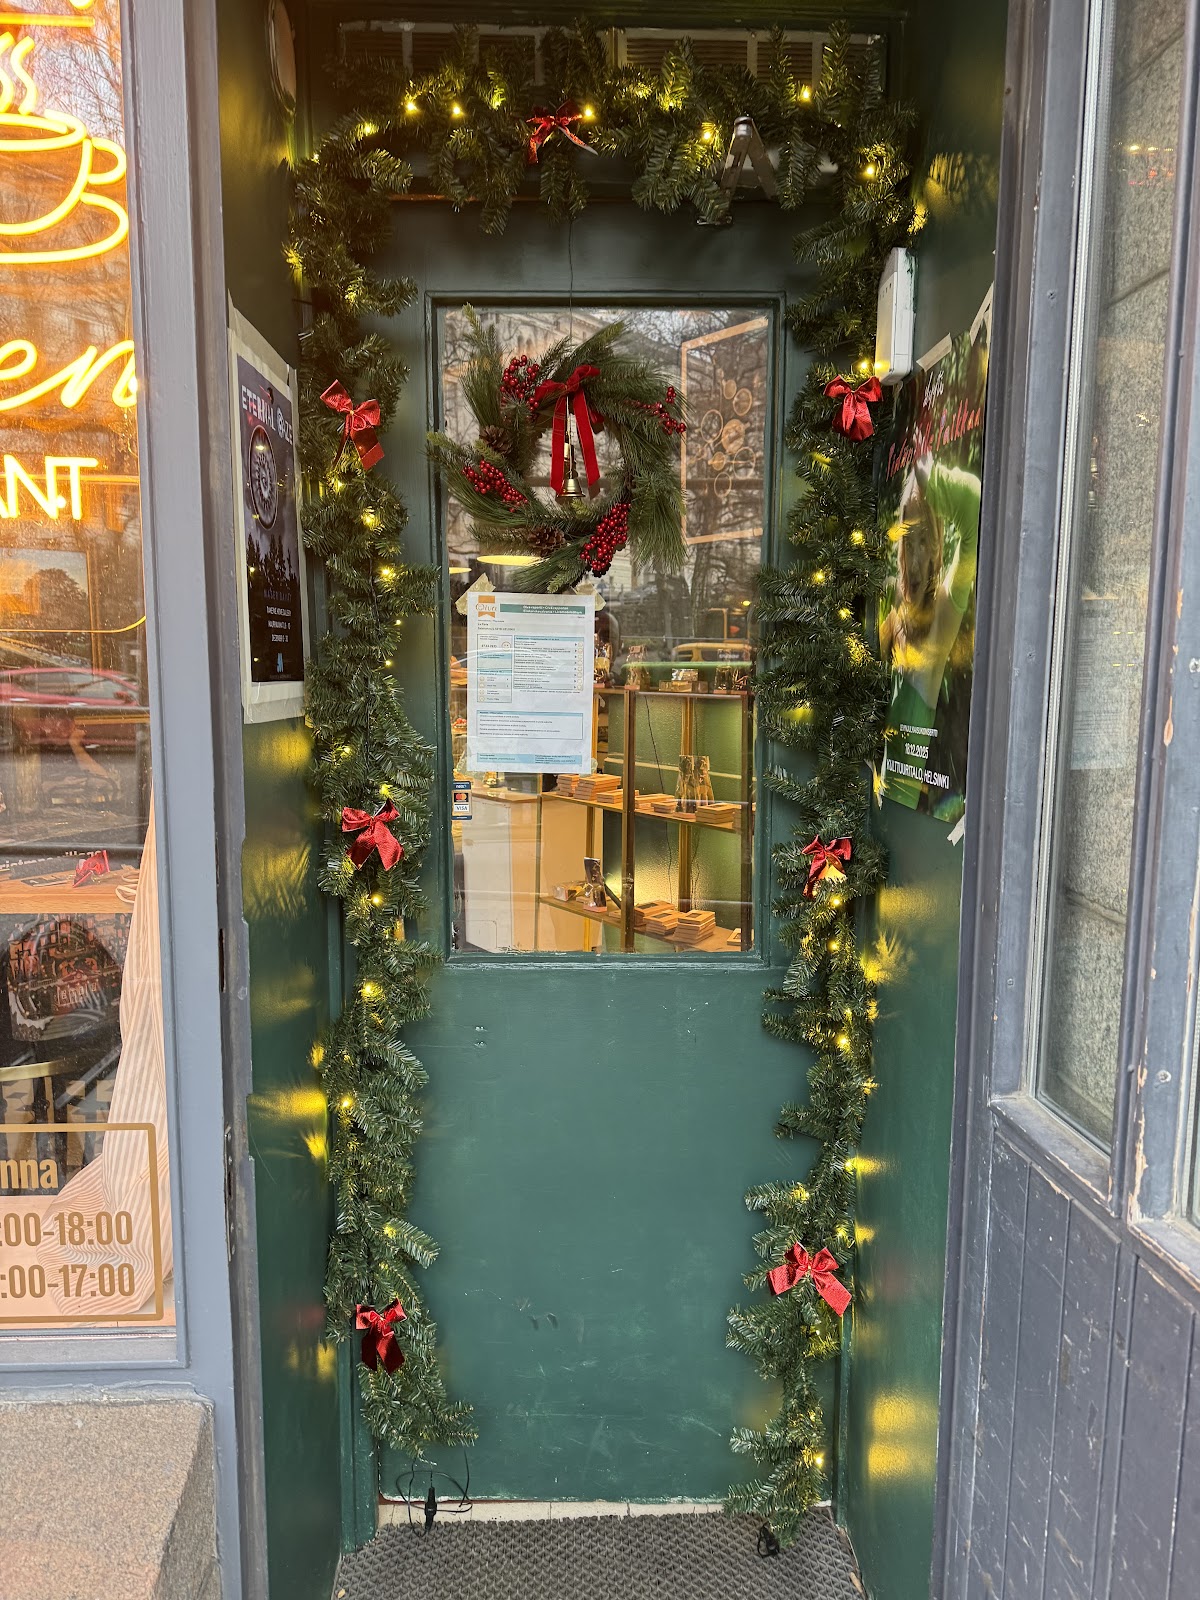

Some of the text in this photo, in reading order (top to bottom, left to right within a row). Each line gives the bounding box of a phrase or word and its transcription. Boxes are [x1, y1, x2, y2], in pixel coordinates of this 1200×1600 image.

[0, 454, 99, 520] NT
[924, 769, 950, 790] HELSINKI
[0, 1263, 136, 1299] :00-17:00
